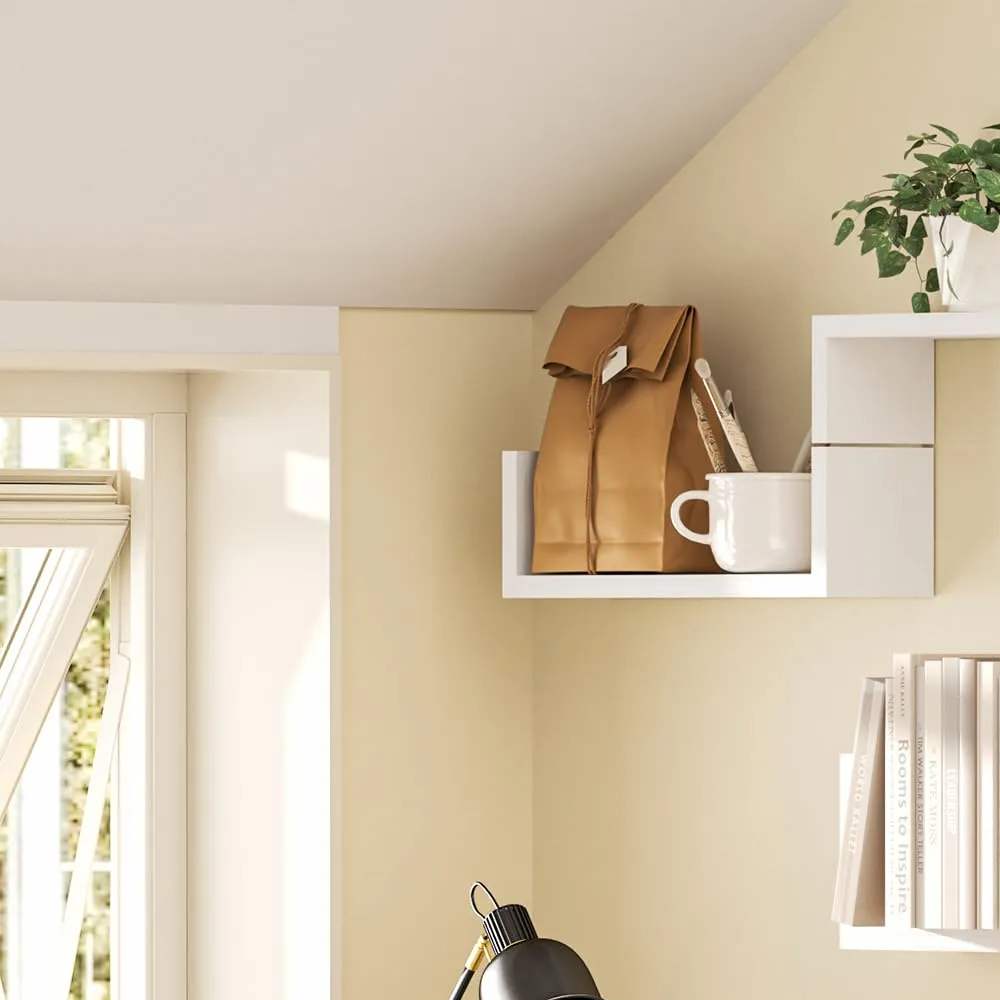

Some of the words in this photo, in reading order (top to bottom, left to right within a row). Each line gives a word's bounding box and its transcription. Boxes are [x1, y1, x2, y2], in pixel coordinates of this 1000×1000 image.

[898, 739, 910, 808] Rooms
[928, 760, 938, 801] KATE
[898, 816, 909, 836] to
[894, 844, 910, 914] Inspire
